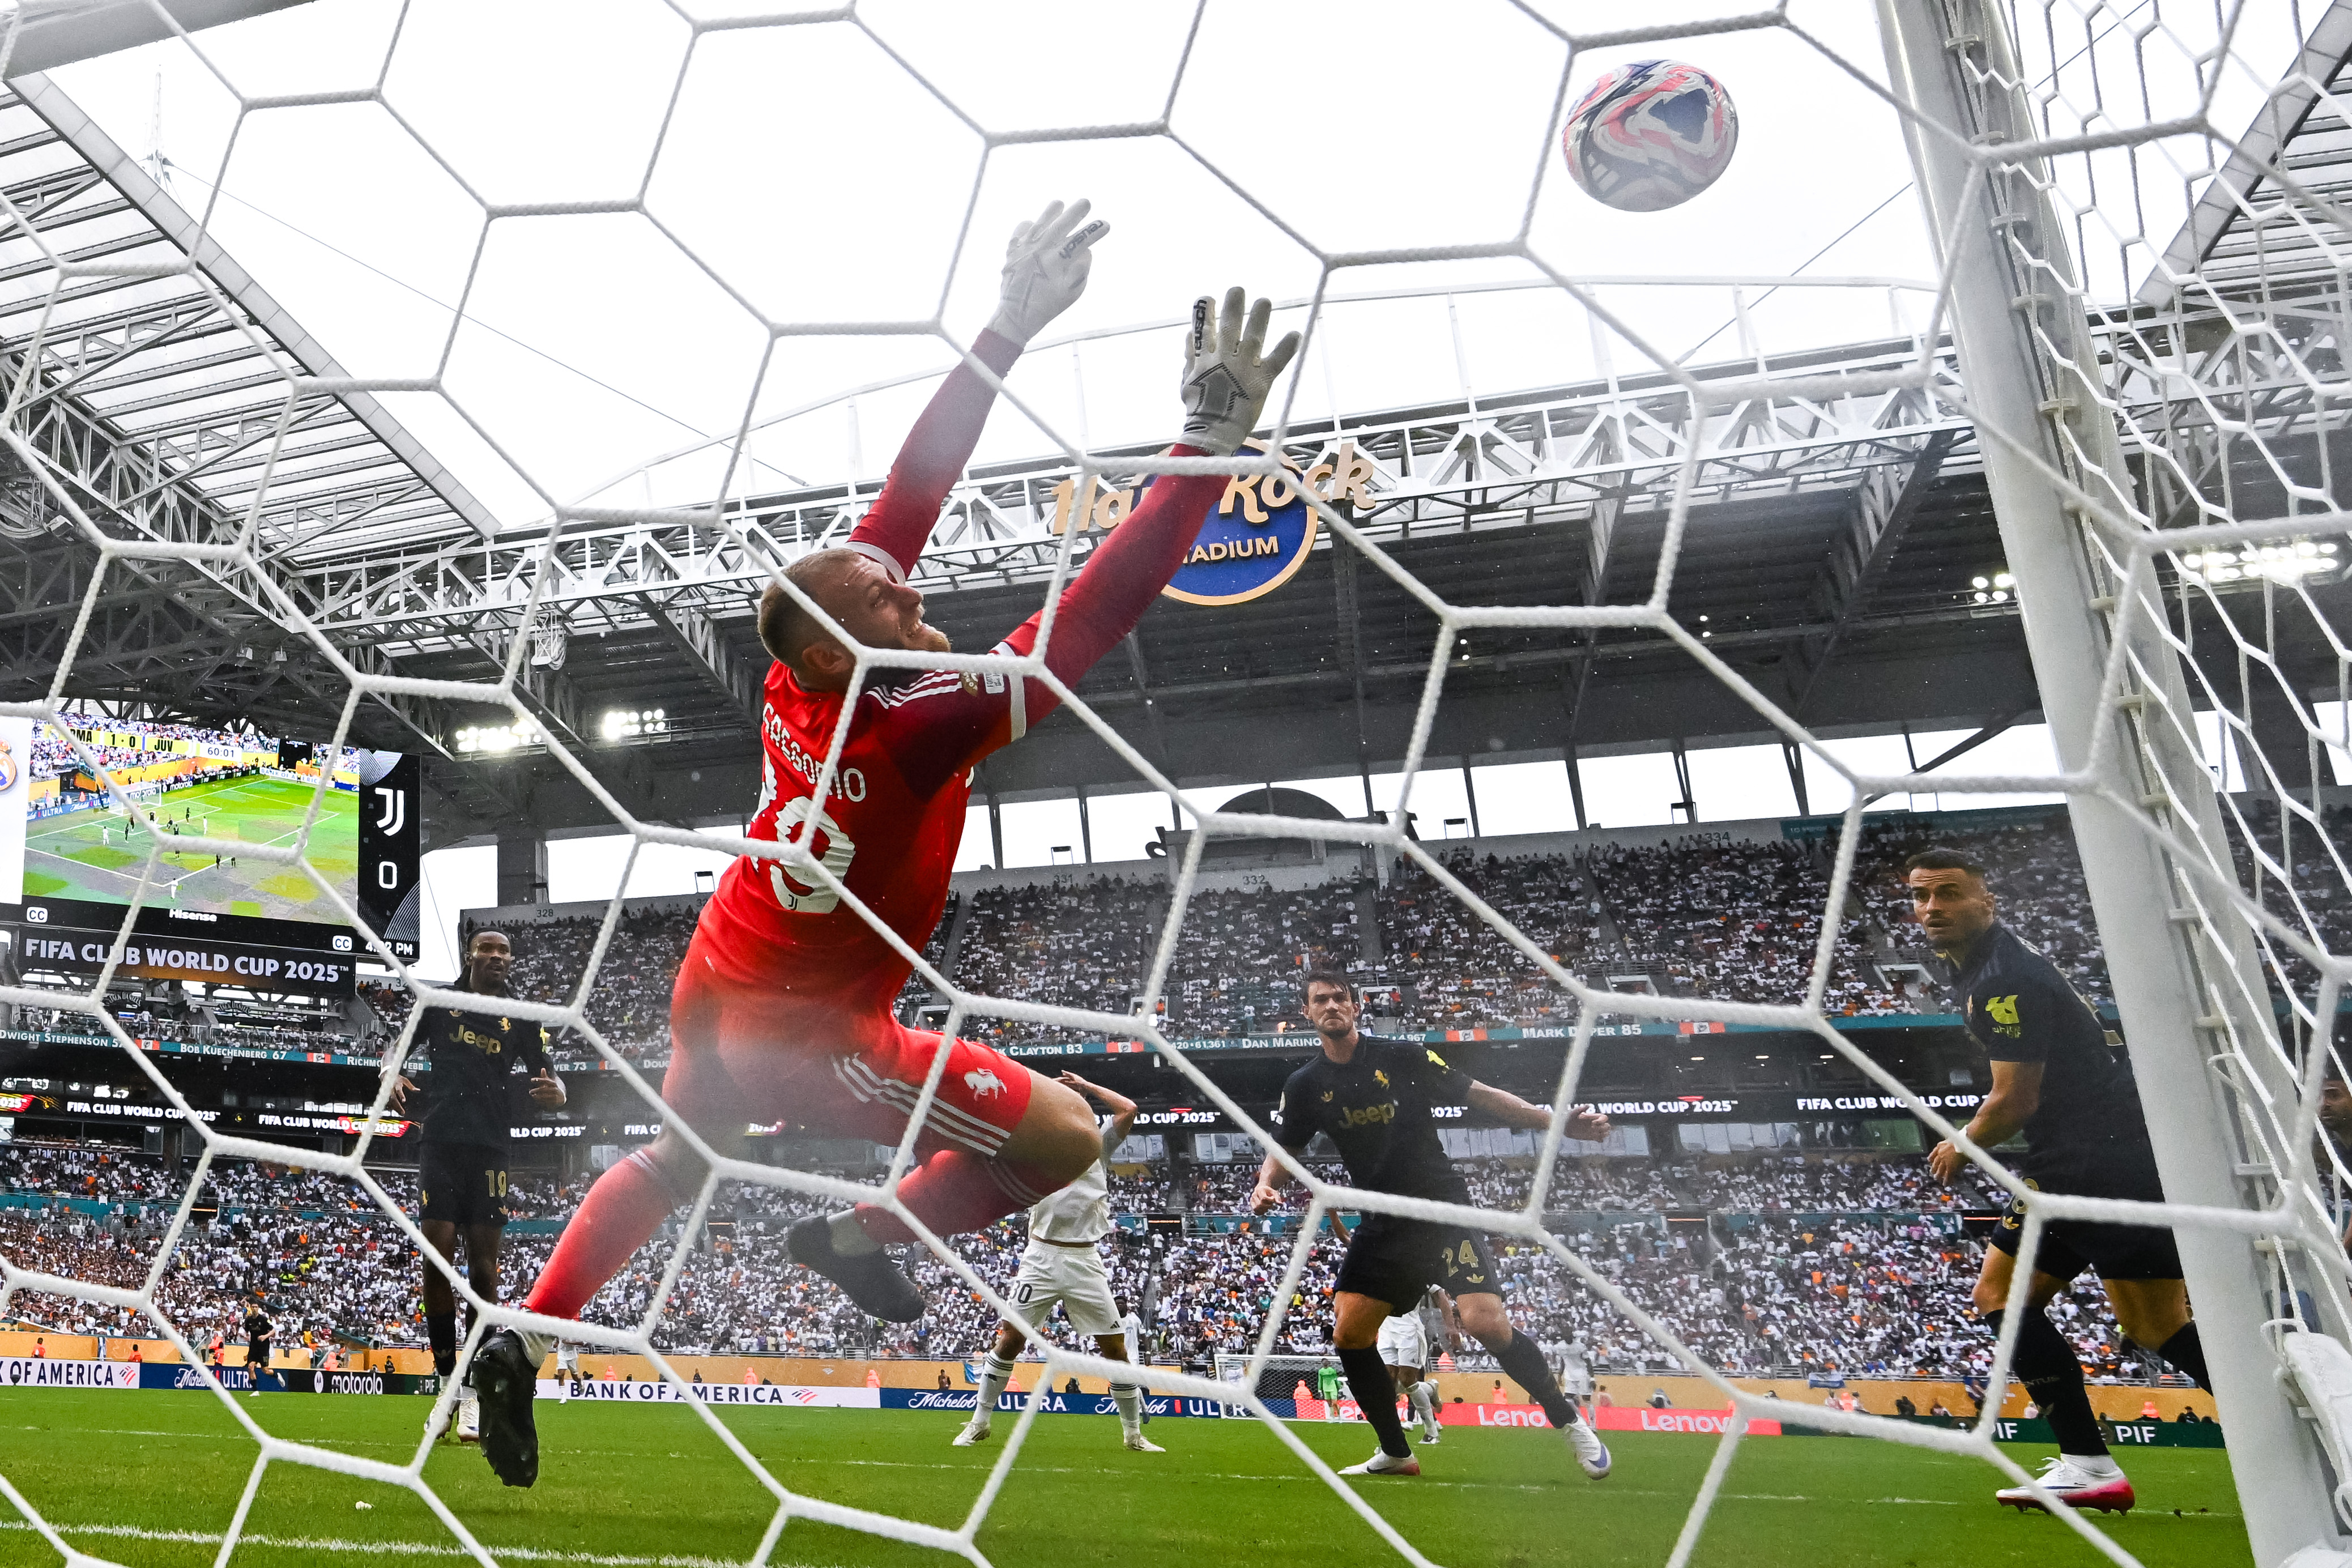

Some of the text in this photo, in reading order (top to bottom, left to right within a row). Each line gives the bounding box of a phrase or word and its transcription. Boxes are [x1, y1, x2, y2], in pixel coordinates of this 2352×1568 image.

[1193, 299, 1207, 357] reusch
[1218, 443, 1376, 524] Rock
[1183, 535, 1279, 564] ADIUM
[129, 736, 136, 748] 0
[154, 738, 173, 752] JUV
[207, 747, 235, 758] 60:01
[42, 806, 63, 817] ULTRA
[1704, 832, 1730, 842] 334
[378, 861, 398, 889] 0
[1242, 874, 1266, 885] 332
[696, 898, 708, 907] 32
[29, 910, 45, 921] CC
[169, 909, 218, 922] Hisense
[536, 909, 554, 918] 328
[335, 938, 351, 949] CC
[396, 942, 413, 956] PM
[26, 938, 76, 961] FIFA
[146, 948, 229, 972] WORLD
[235, 956, 279, 977] CUP
[0, 1029, 41, 1042] DWIGHT
[44, 1033, 108, 1047] STEPHENSON
[1522, 1023, 1642, 1038] MARK DPER 85
[449, 1024, 502, 1055] Jeep
[1242, 1037, 1322, 1049] DAN MARINO
[180, 1043, 287, 1060] BOB KUECHENBERG 67
[1009, 1046, 1062, 1056] CLAYTON
[1066, 1043, 1084, 1054] 83
[573, 1062, 587, 1071] 73
[67, 1101, 92, 1114] FIFA
[93, 1103, 121, 1115] CLUB
[123, 1106, 163, 1118] WORLD
[1597, 1101, 1655, 1114] WORLD
[1658, 1101, 1689, 1113] CUP
[1796, 1094, 1979, 1110] FIFA CLUB WOLD CUP
[258, 1114, 282, 1126] FIFA
[283, 1117, 310, 1128] CLUB
[312, 1118, 350, 1130] WORLD
[351, 1120, 369, 1131] CU
[1102, 1113, 1150, 1125] WLD
[1152, 1112, 1179, 1123] CUP
[1338, 1102, 1395, 1129] Jeep
[510, 1127, 530, 1137] RLD
[531, 1127, 553, 1137] CUP
[624, 1124, 648, 1135] FIFA
[1441, 1239, 1479, 1277] 24
[37, 1362, 114, 1386] AMERICA
[223, 1370, 253, 1388] ULTR
[331, 1371, 383, 1395] motorola
[424, 1379, 435, 1394] PIF
[570, 1382, 631, 1399] BANK
[639, 1384, 667, 1400] OF
[908, 1391, 978, 1408] Michelob
[1477, 1405, 1547, 1427] Leno
[1641, 1410, 1749, 1433] Lenov
[1995, 1422, 2018, 1439] IF
[2115, 1425, 2156, 1443] PIF
